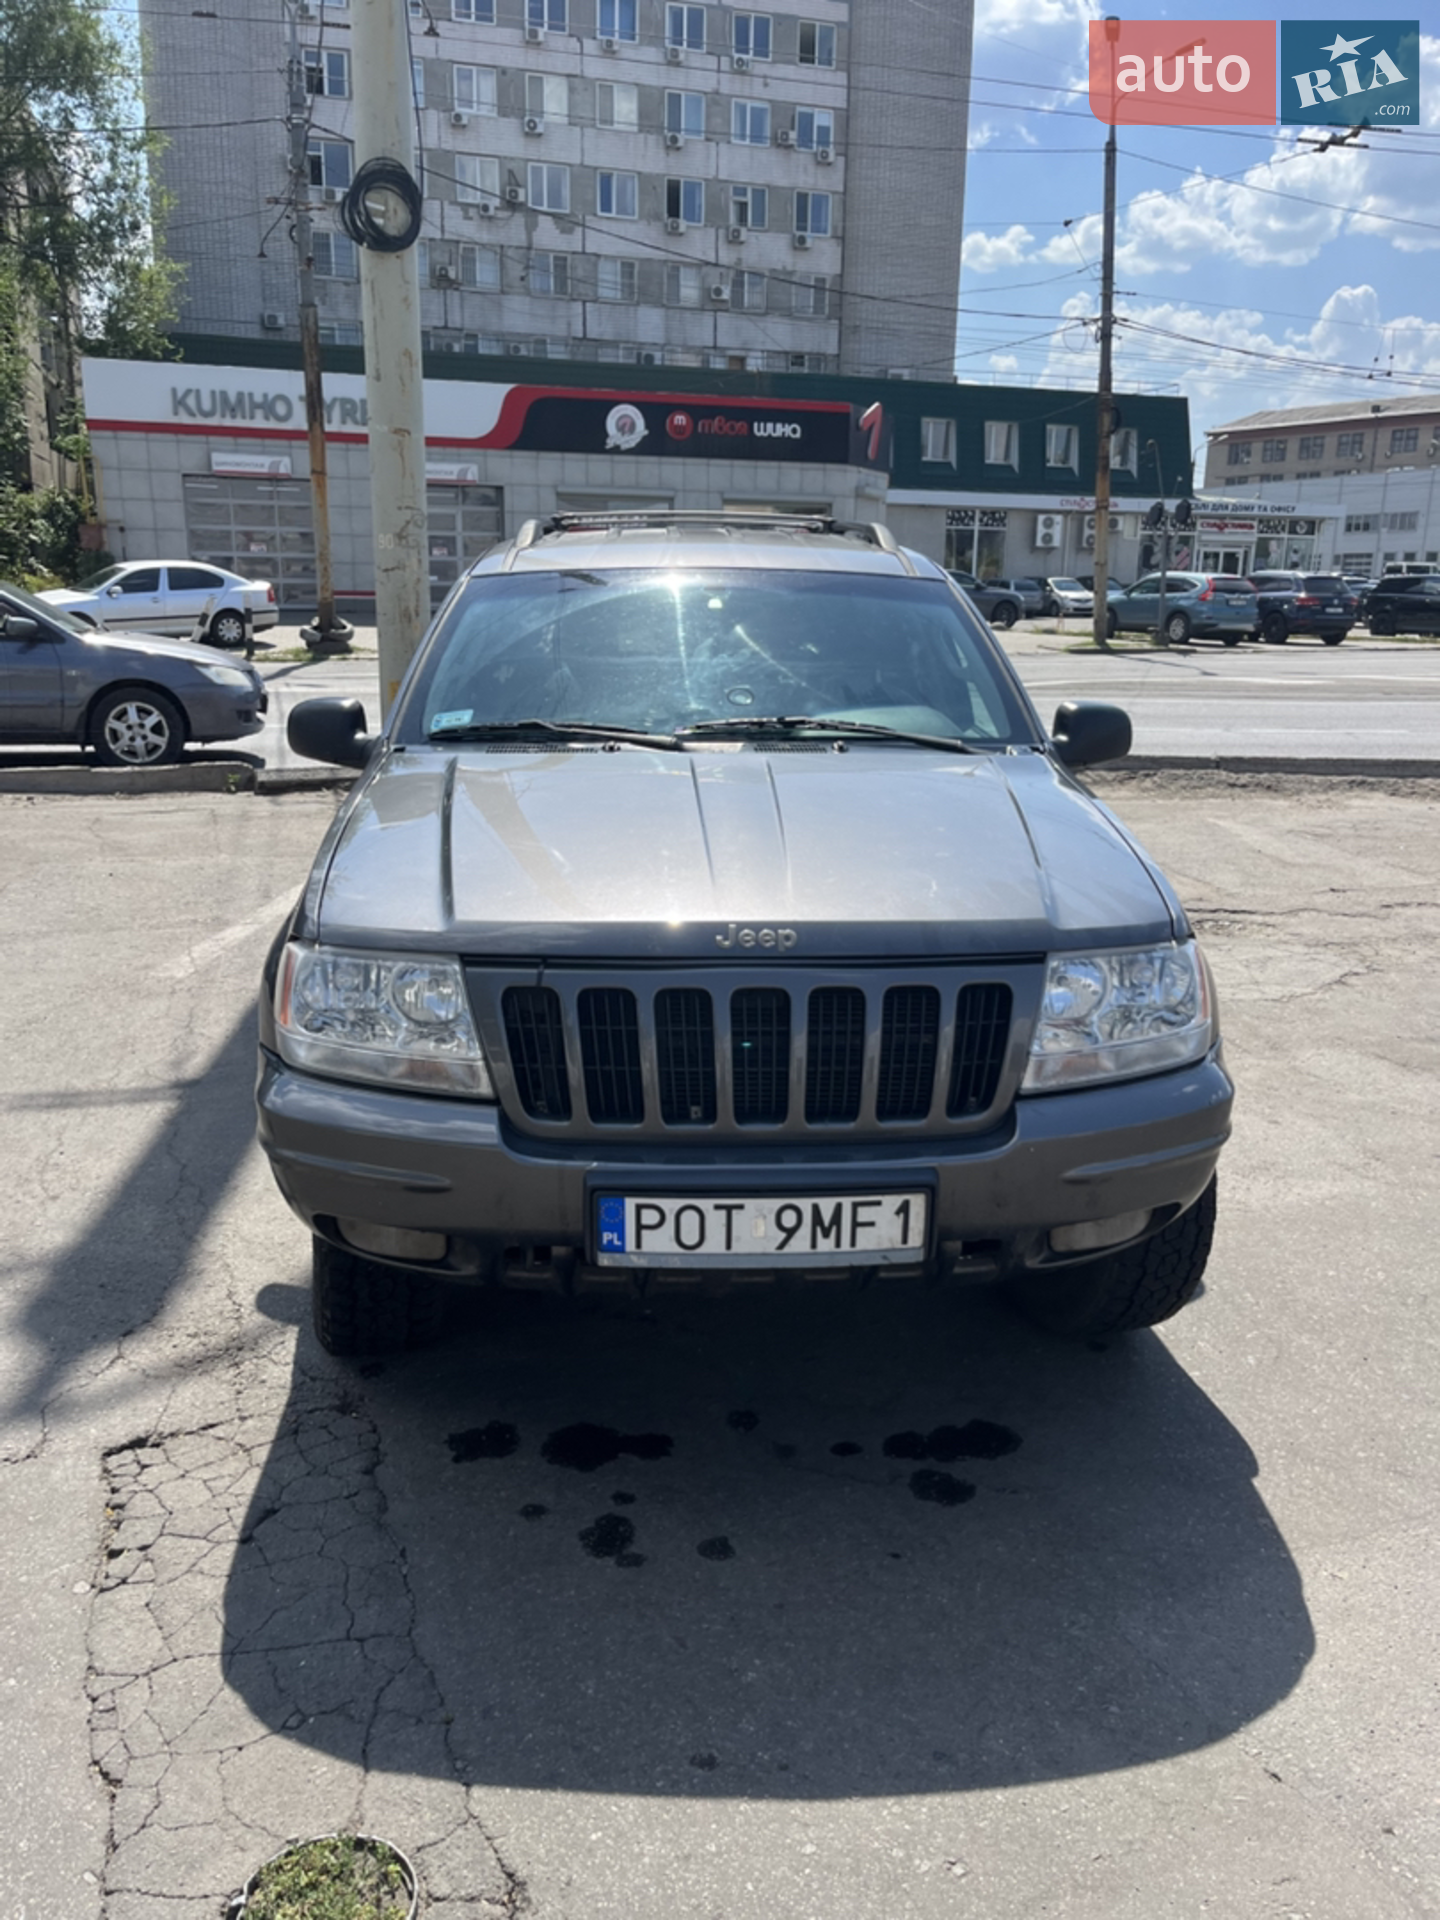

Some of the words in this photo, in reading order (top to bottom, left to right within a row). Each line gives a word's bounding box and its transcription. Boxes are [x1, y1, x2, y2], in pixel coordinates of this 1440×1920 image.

[171, 386, 294, 423] KUMHO
[298, 395, 368, 426] YR
[715, 923, 798, 952] Jeep
[602, 1231, 622, 1246] PL
[634, 1203, 746, 1251] POT
[773, 1198, 911, 1251] 9MF1
